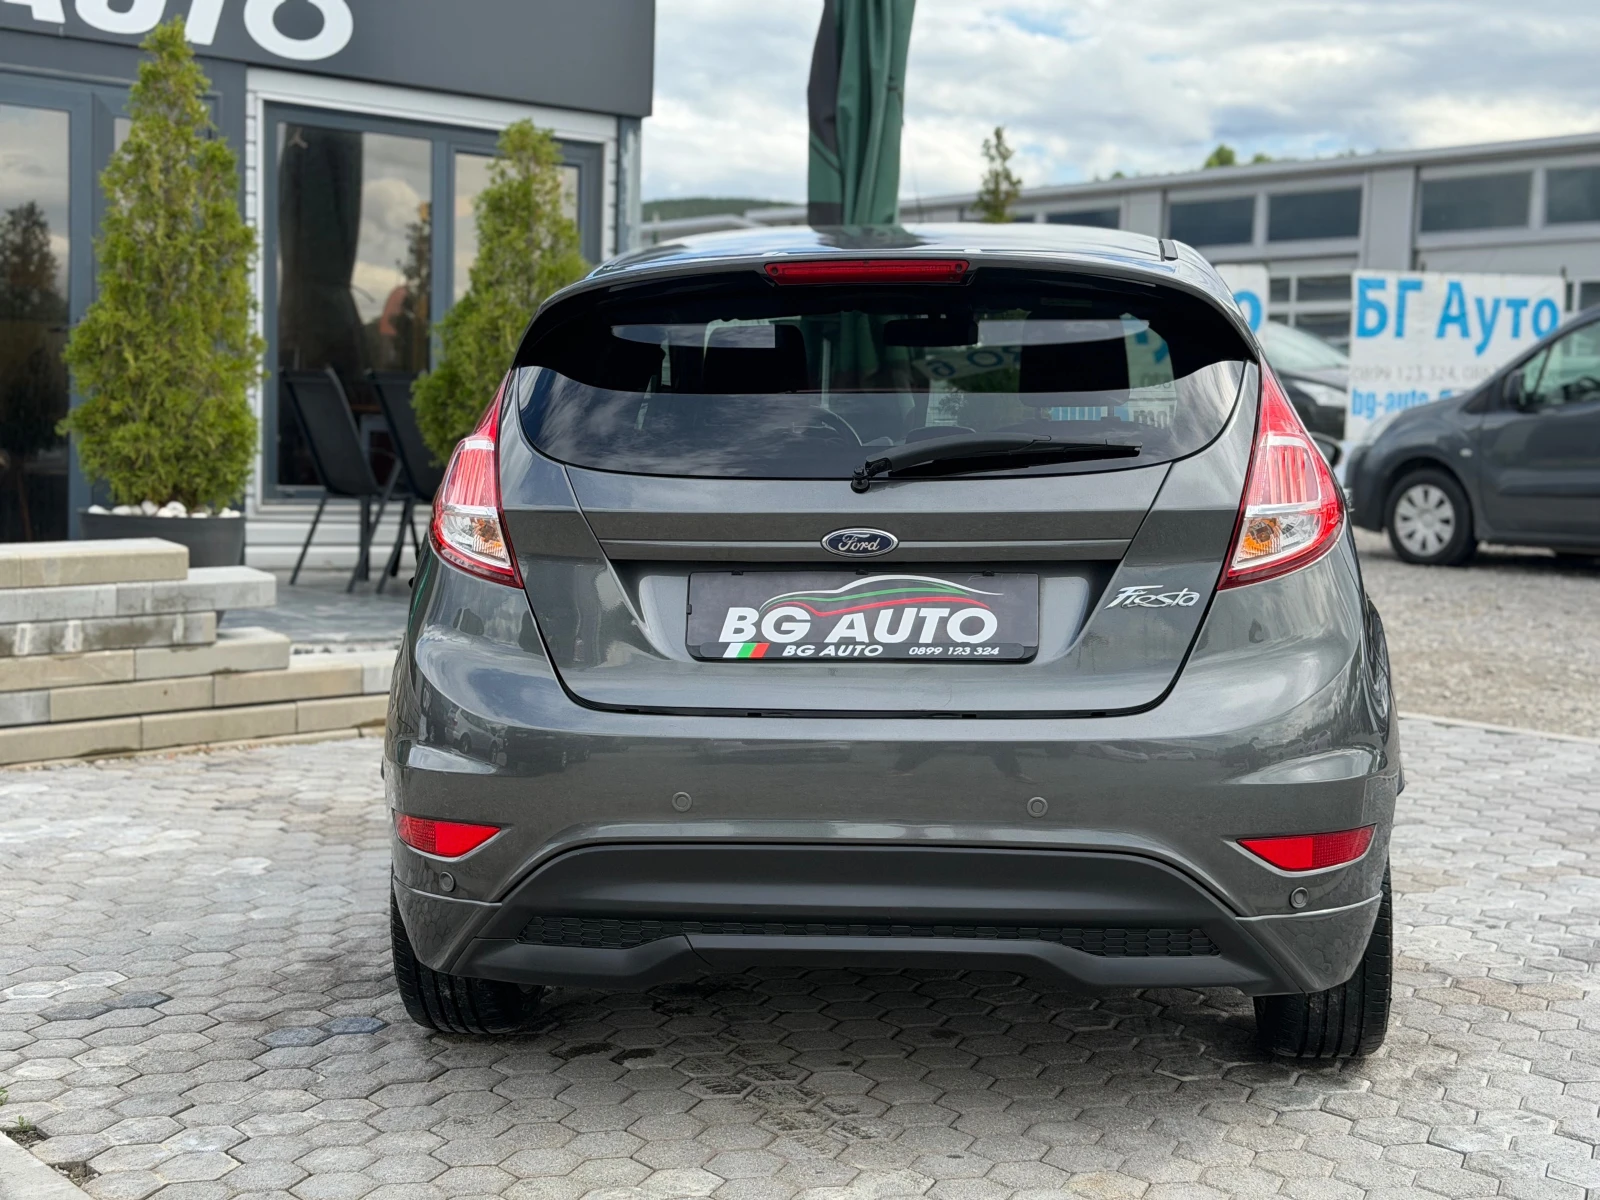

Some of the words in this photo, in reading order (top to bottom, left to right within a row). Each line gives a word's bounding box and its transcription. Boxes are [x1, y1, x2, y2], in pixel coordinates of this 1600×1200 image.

[0, 0, 354, 61] TO
[1356, 278, 1424, 338] БГ
[1436, 281, 1560, 357] Ауто
[838, 533, 881, 551] Ford
[1103, 584, 1201, 610] Fiesta
[718, 606, 812, 643] BG
[824, 607, 999, 644] AUTO
[782, 644, 815, 657] BG
[818, 644, 884, 657] AUTO
[908, 646, 943, 656] 0899
[946, 646, 972, 656] 123
[973, 646, 1000, 656] 324
